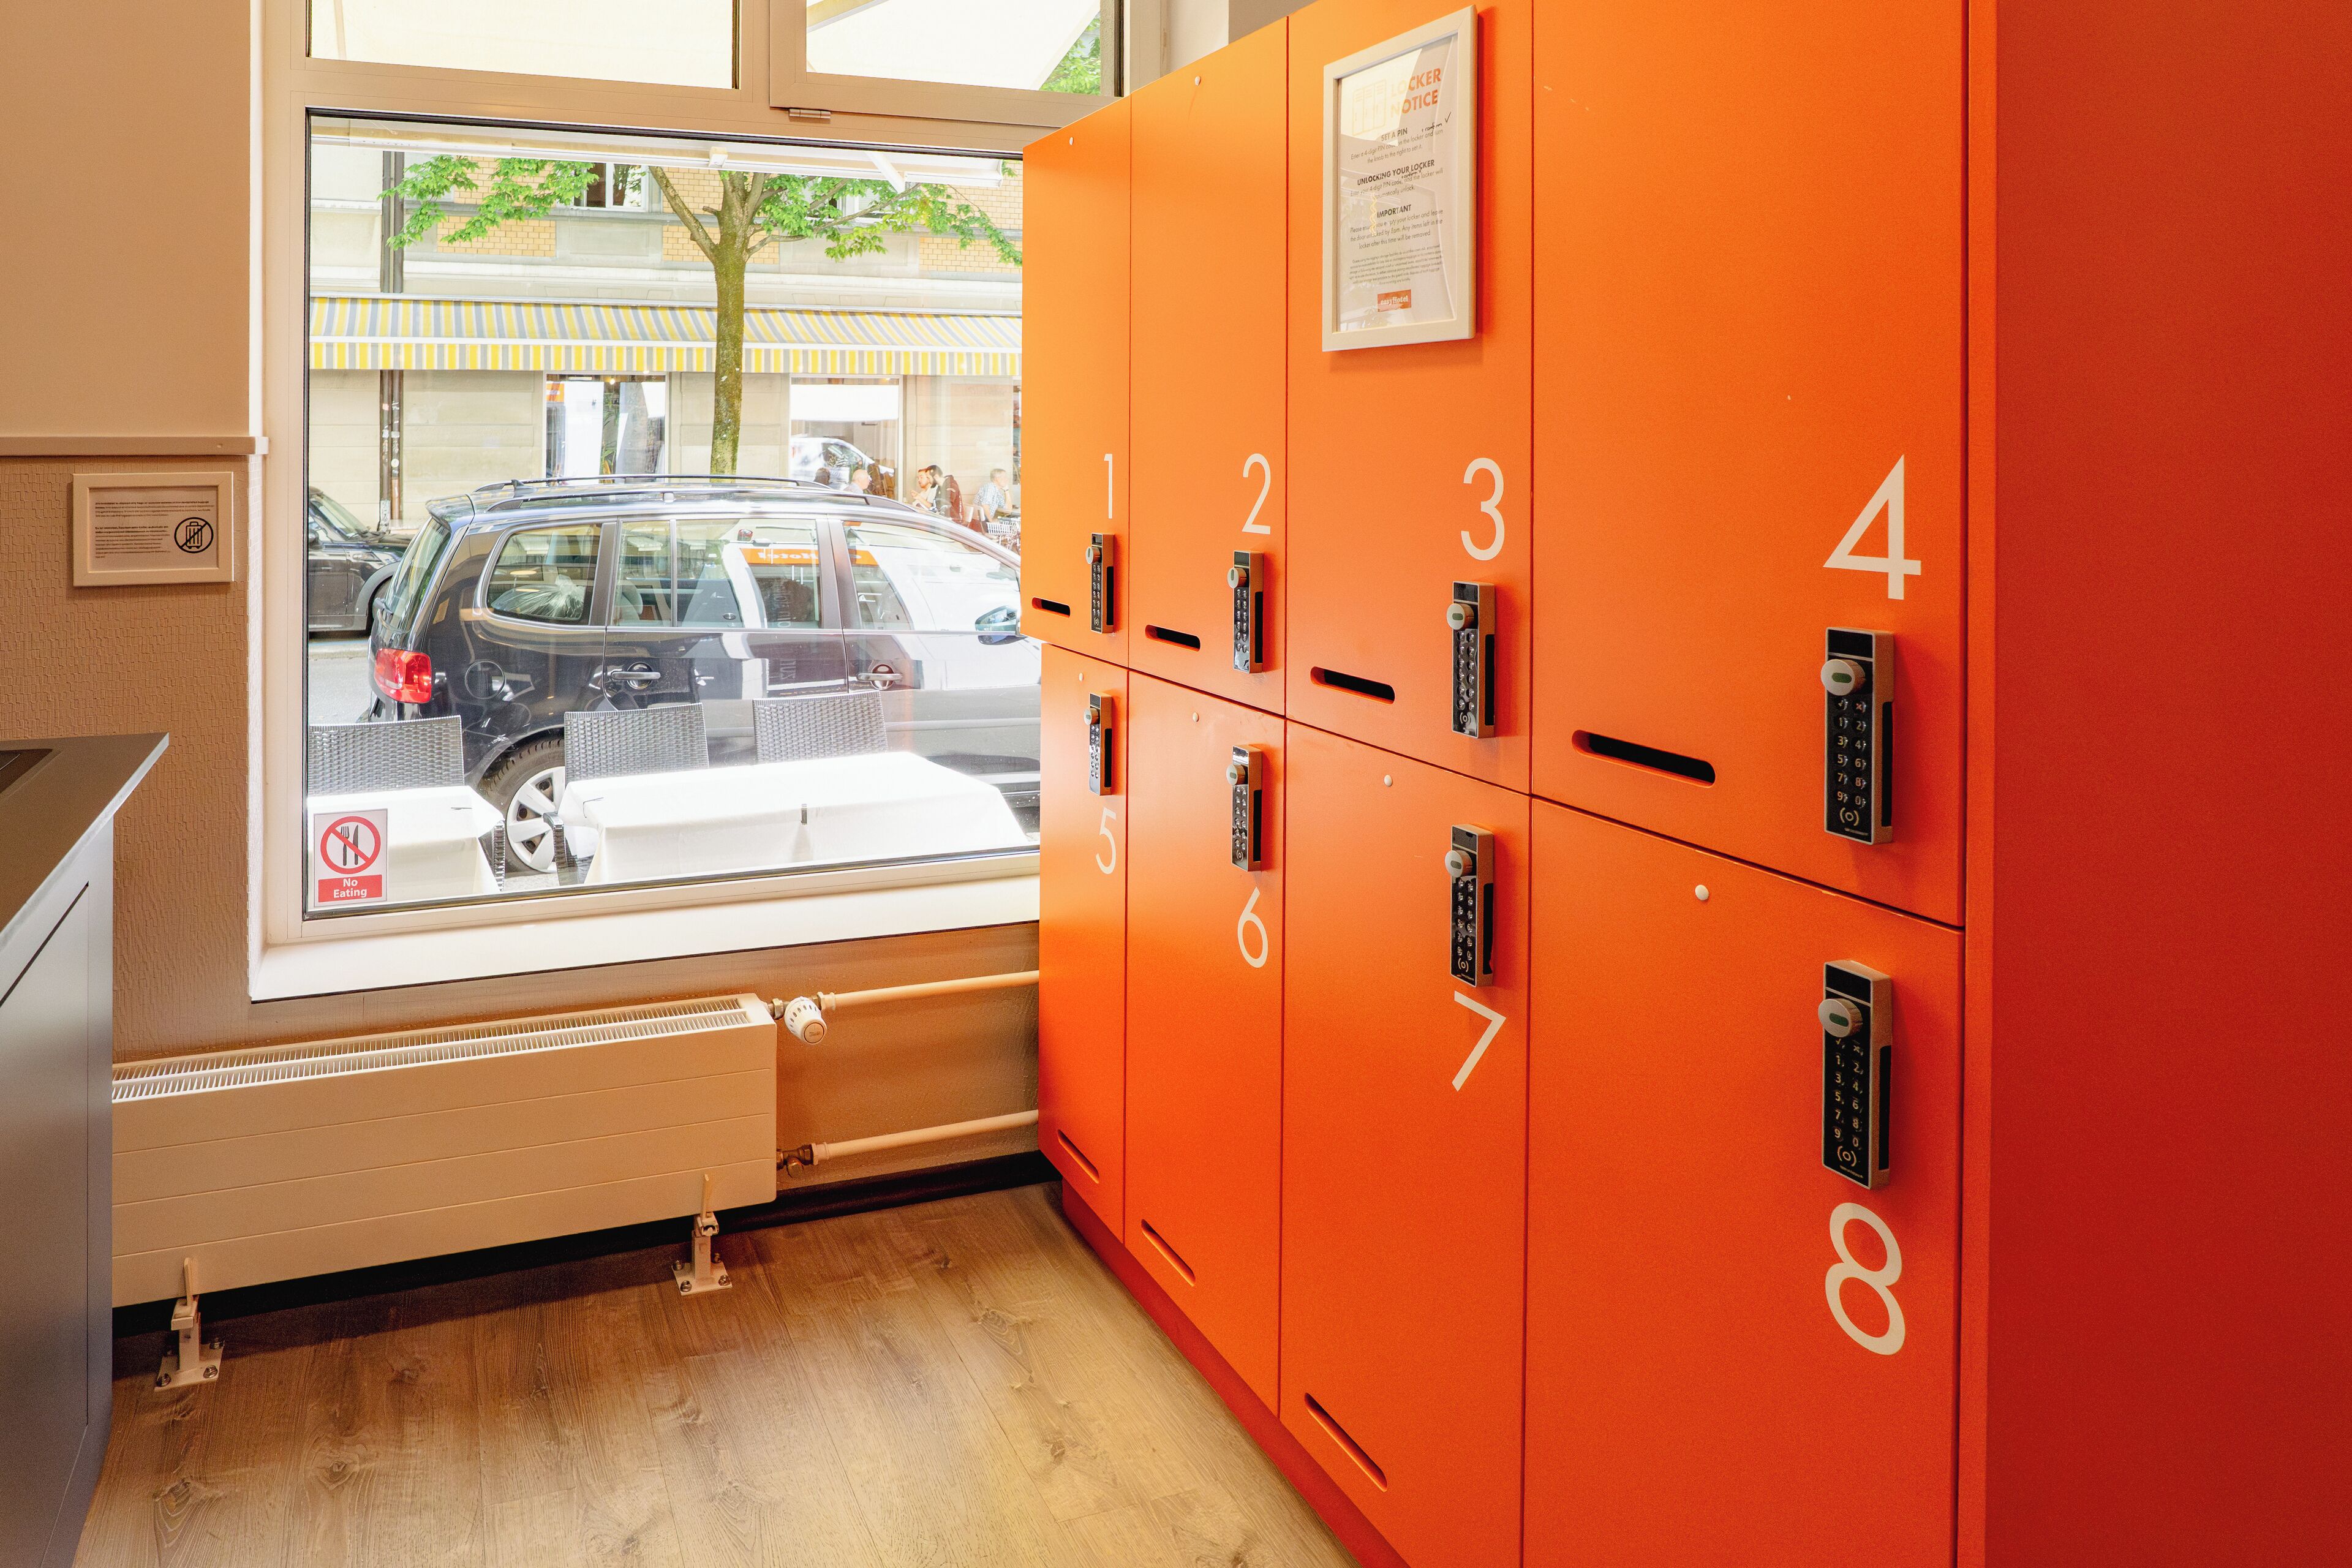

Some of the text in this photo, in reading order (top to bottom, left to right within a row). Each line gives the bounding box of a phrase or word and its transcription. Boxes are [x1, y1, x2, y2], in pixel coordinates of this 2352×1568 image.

[1390, 68, 1441, 97] LOCKER
[1390, 89, 1438, 118] NOTICE
[1397, 127, 1408, 137] PIN
[1357, 159, 1434, 186] UNLOCKING YOUR LOCKER
[1376, 204, 1411, 218] IMPORTANT
[1411, 229, 1431, 239] removed
[1380, 295, 1409, 306] easyHotel
[1103, 453, 1921, 600] 1 2 3 4
[343, 878, 358, 888] No
[1095, 807, 1268, 968] 5 6
[333, 888, 368, 899] Eating
[1452, 990, 1905, 1355] 7 8
